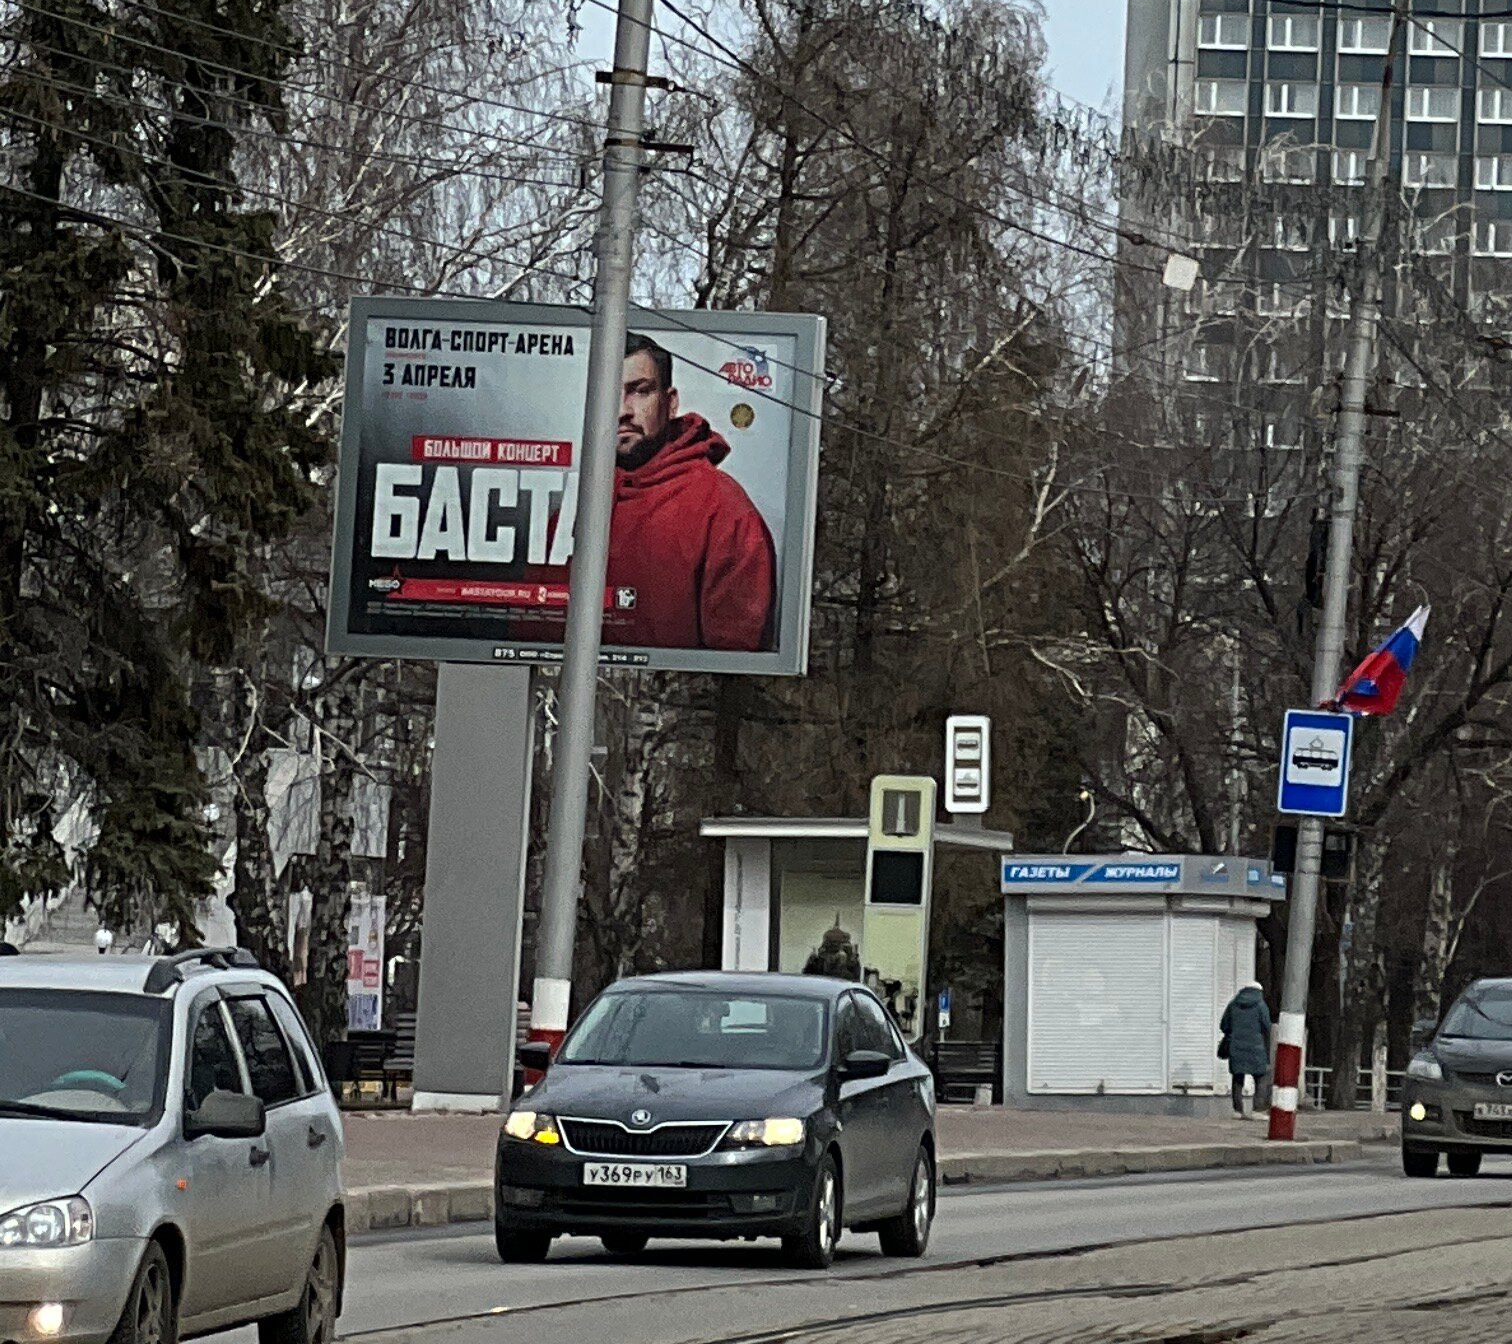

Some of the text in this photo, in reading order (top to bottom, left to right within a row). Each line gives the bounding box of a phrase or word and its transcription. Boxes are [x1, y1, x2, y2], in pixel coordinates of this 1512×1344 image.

[385, 327, 575, 356] ВОЛГА-СПОРТ-АРЕНА
[382, 363, 476, 389] 3 АПРЕЛЯ
[497, 443, 560, 462] КОНЦЕРТ
[1009, 867, 1178, 879] ГАЗЕТЫ ЖУРНАЛЫ
